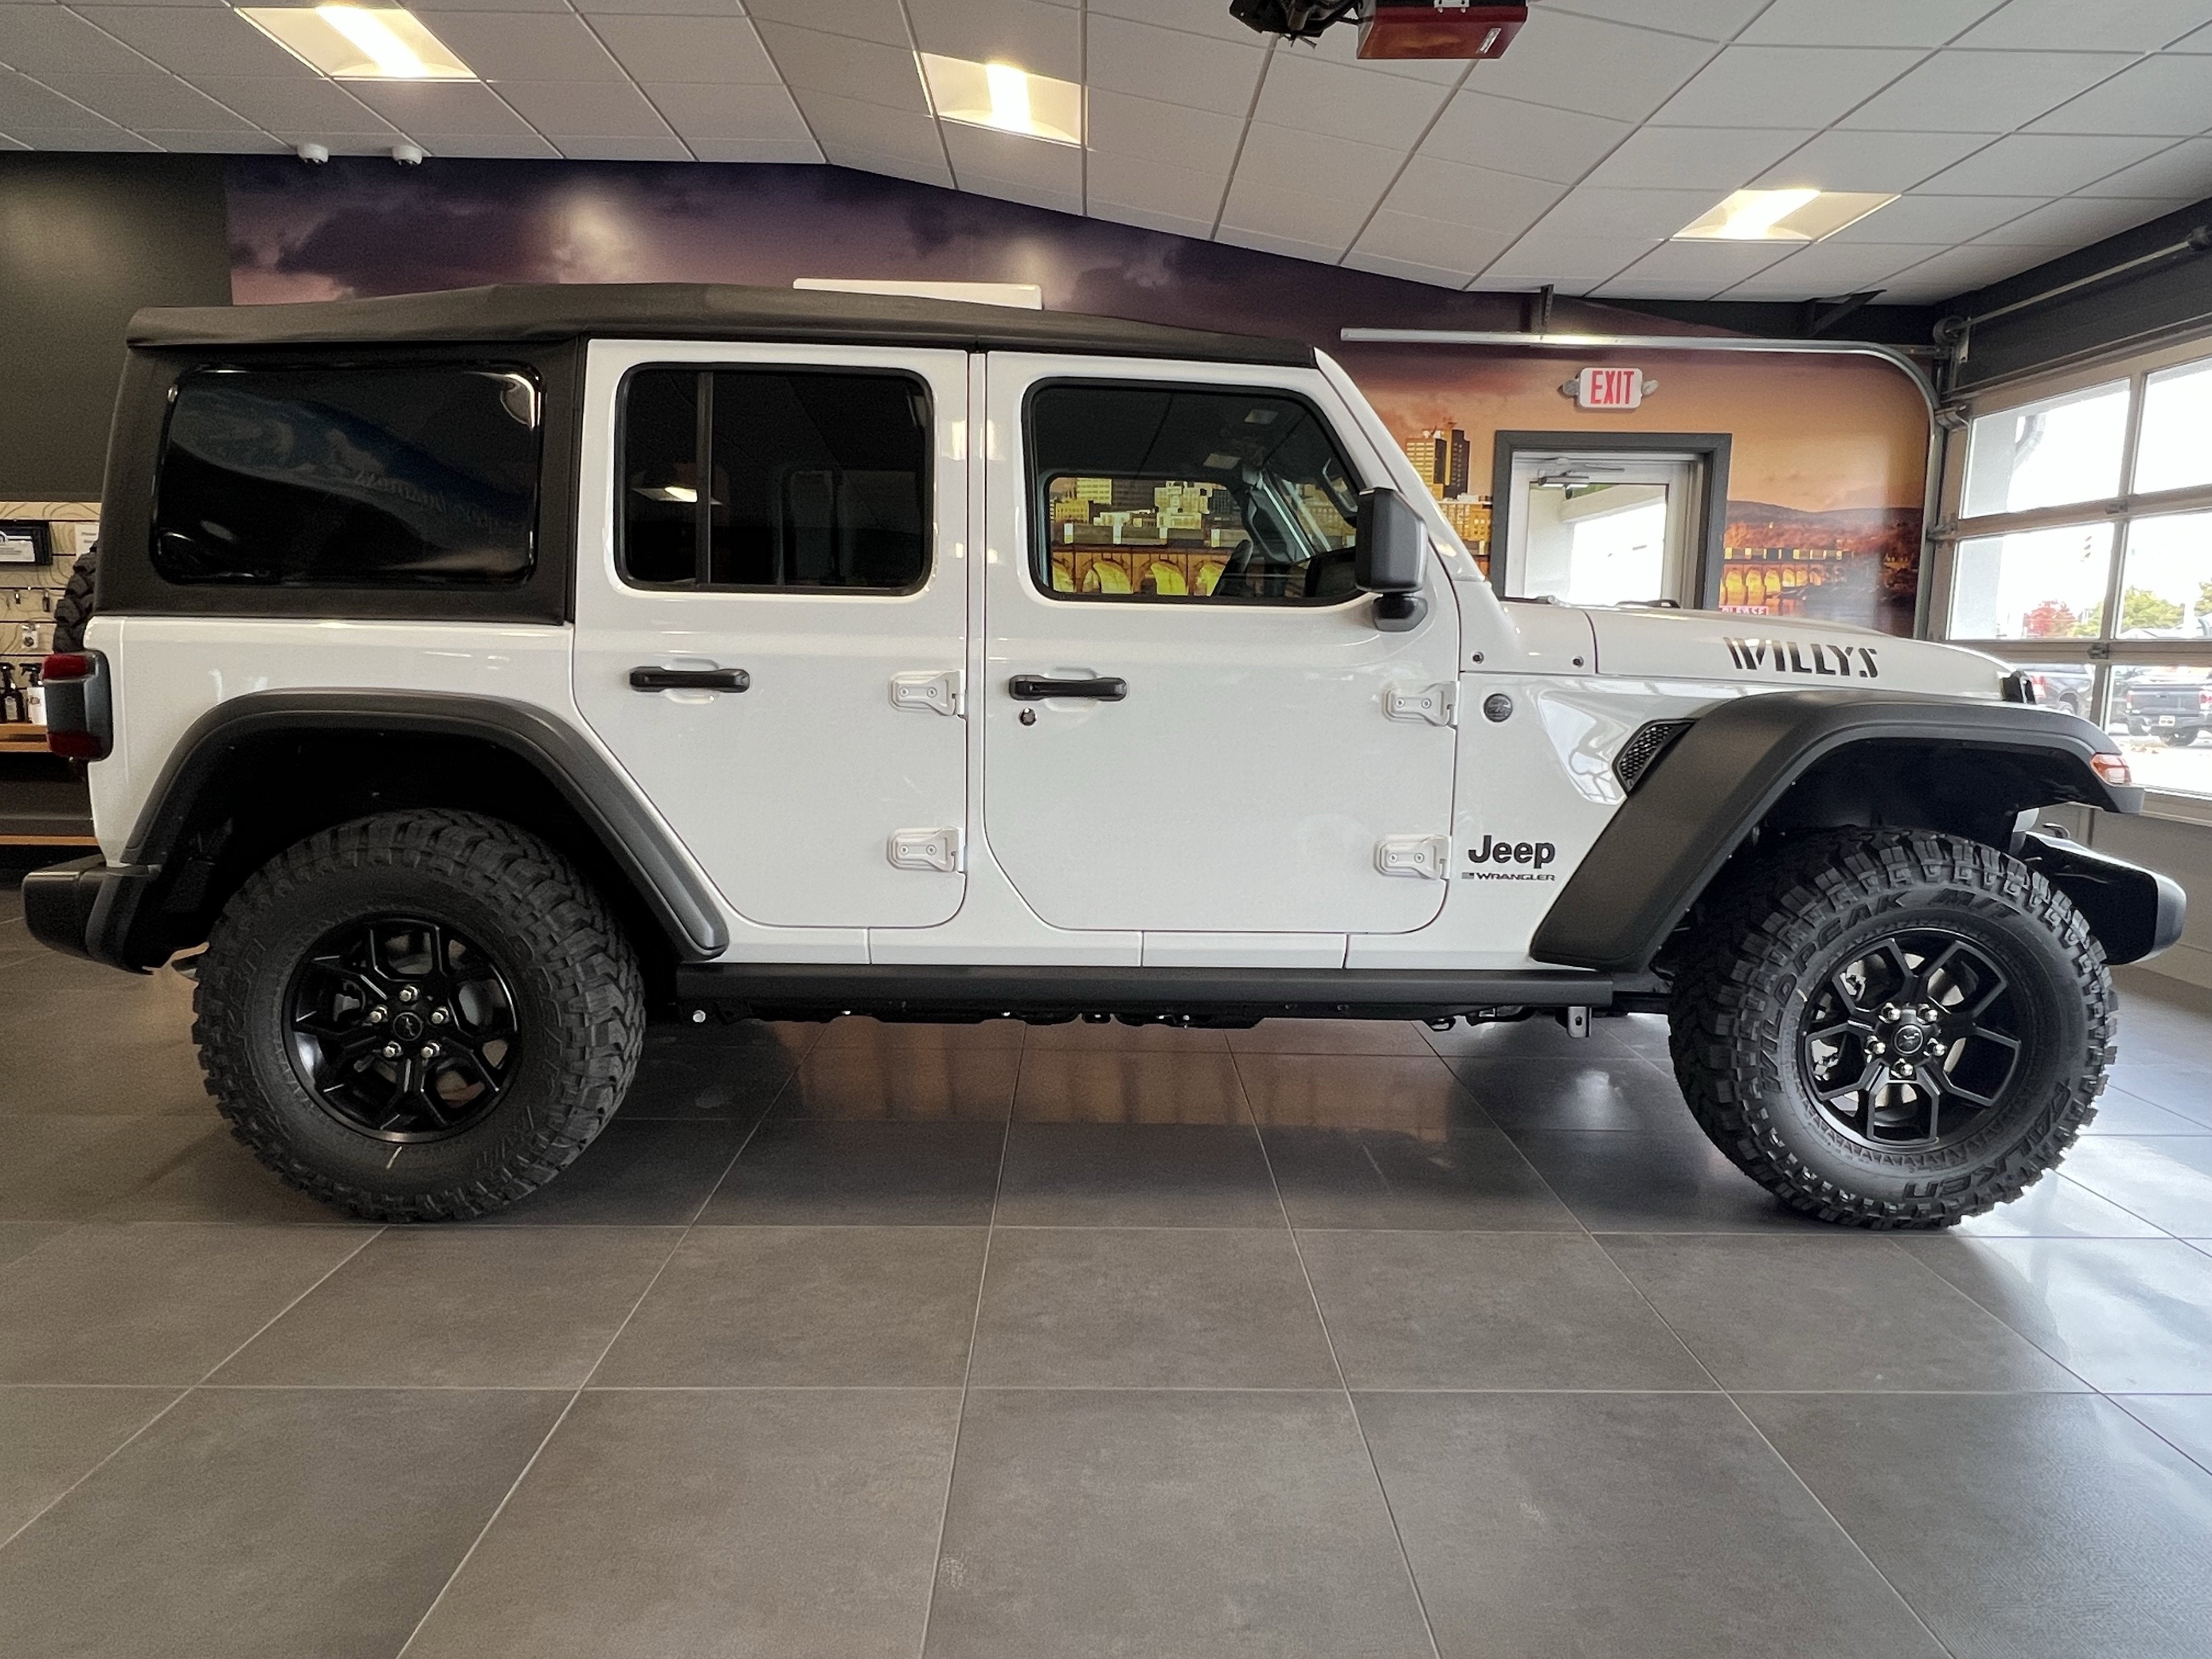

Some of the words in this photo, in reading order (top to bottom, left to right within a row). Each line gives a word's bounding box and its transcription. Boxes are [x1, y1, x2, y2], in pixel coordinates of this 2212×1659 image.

[1590, 370, 1634, 404] EXIT
[1723, 637, 1878, 678] WILLYS
[1468, 835, 1555, 868] Jeep
[1476, 872, 1555, 881] WRANGLER
[1760, 890, 1910, 1092] WILDPEAK
